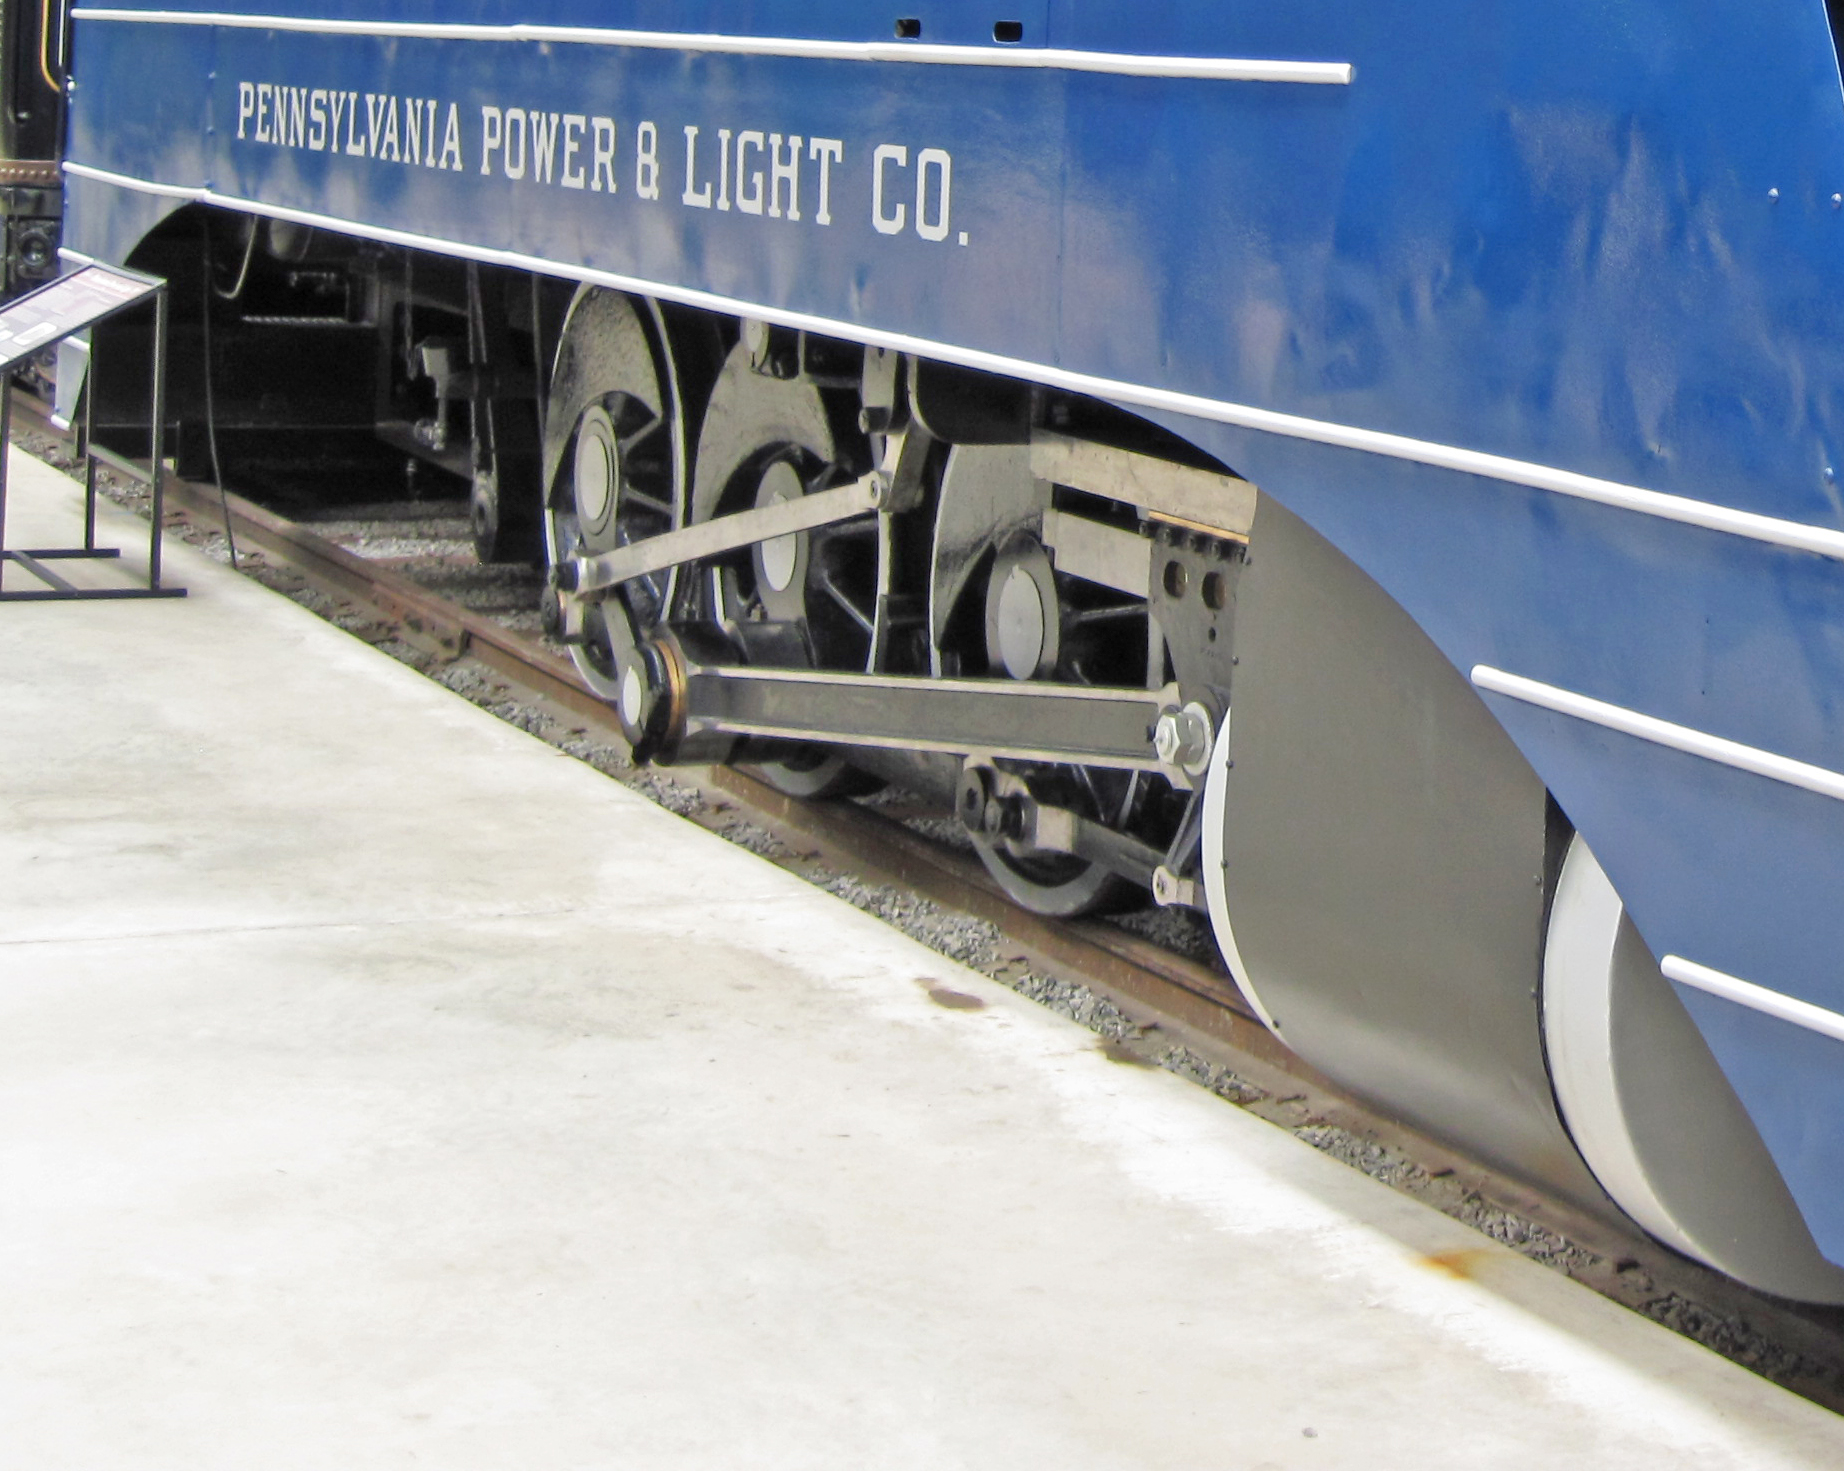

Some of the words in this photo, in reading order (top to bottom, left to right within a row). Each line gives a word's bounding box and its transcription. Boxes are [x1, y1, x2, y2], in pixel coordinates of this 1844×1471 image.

[237, 81, 463, 172] PENNSYLVANIA
[480, 105, 617, 195] POWER
[636, 121, 660, 200] &
[682, 125, 843, 226] LIGHT
[871, 143, 969, 247] CO.
